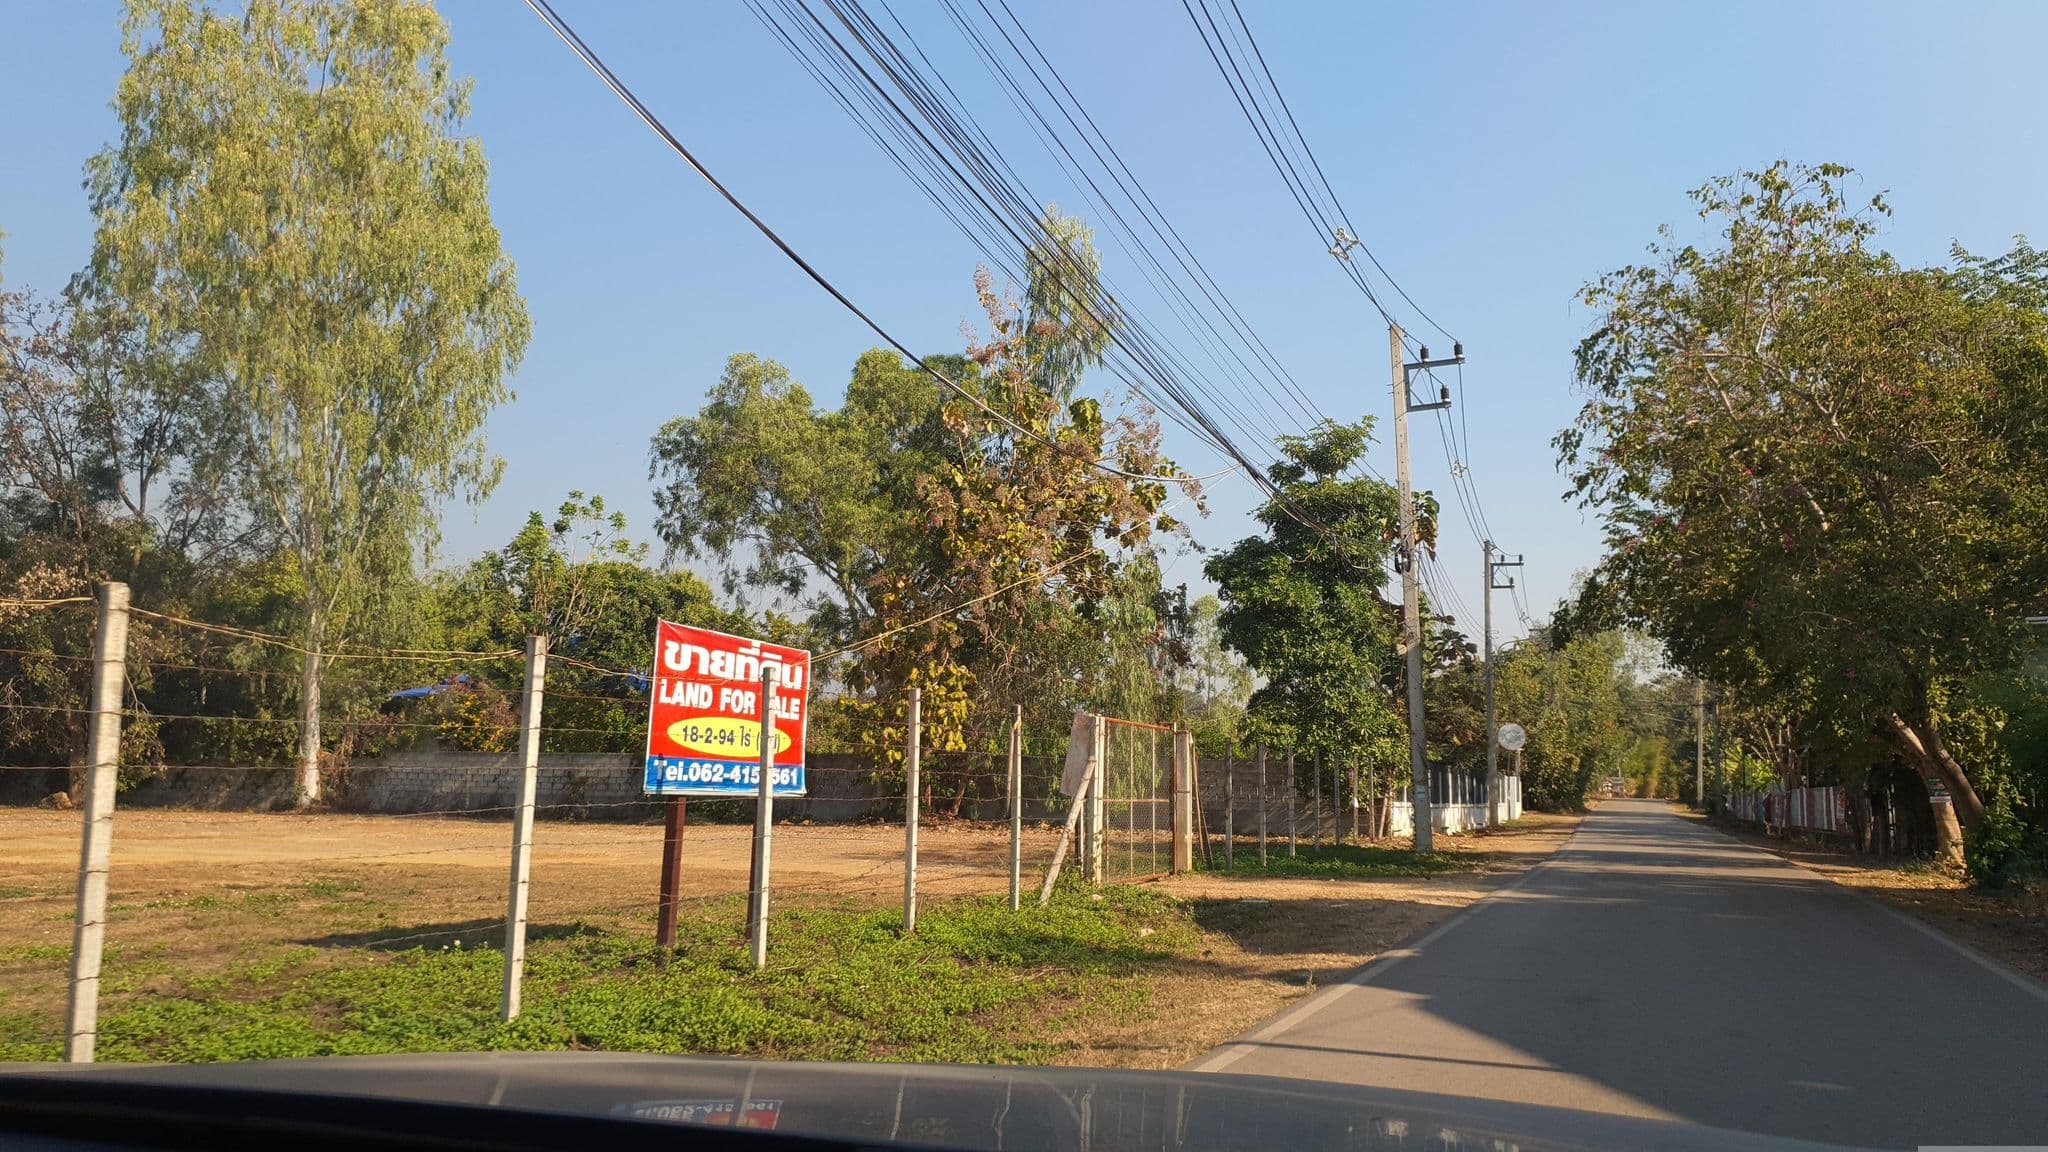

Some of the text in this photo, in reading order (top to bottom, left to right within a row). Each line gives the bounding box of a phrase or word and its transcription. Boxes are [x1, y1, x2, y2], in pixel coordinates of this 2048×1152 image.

[659, 679, 801, 721] LAND FOR ALE
[682, 725, 735, 746] 18-2-94
[740, 726, 752, 747] ไร่
[653, 759, 798, 786] Tel.062-415561
